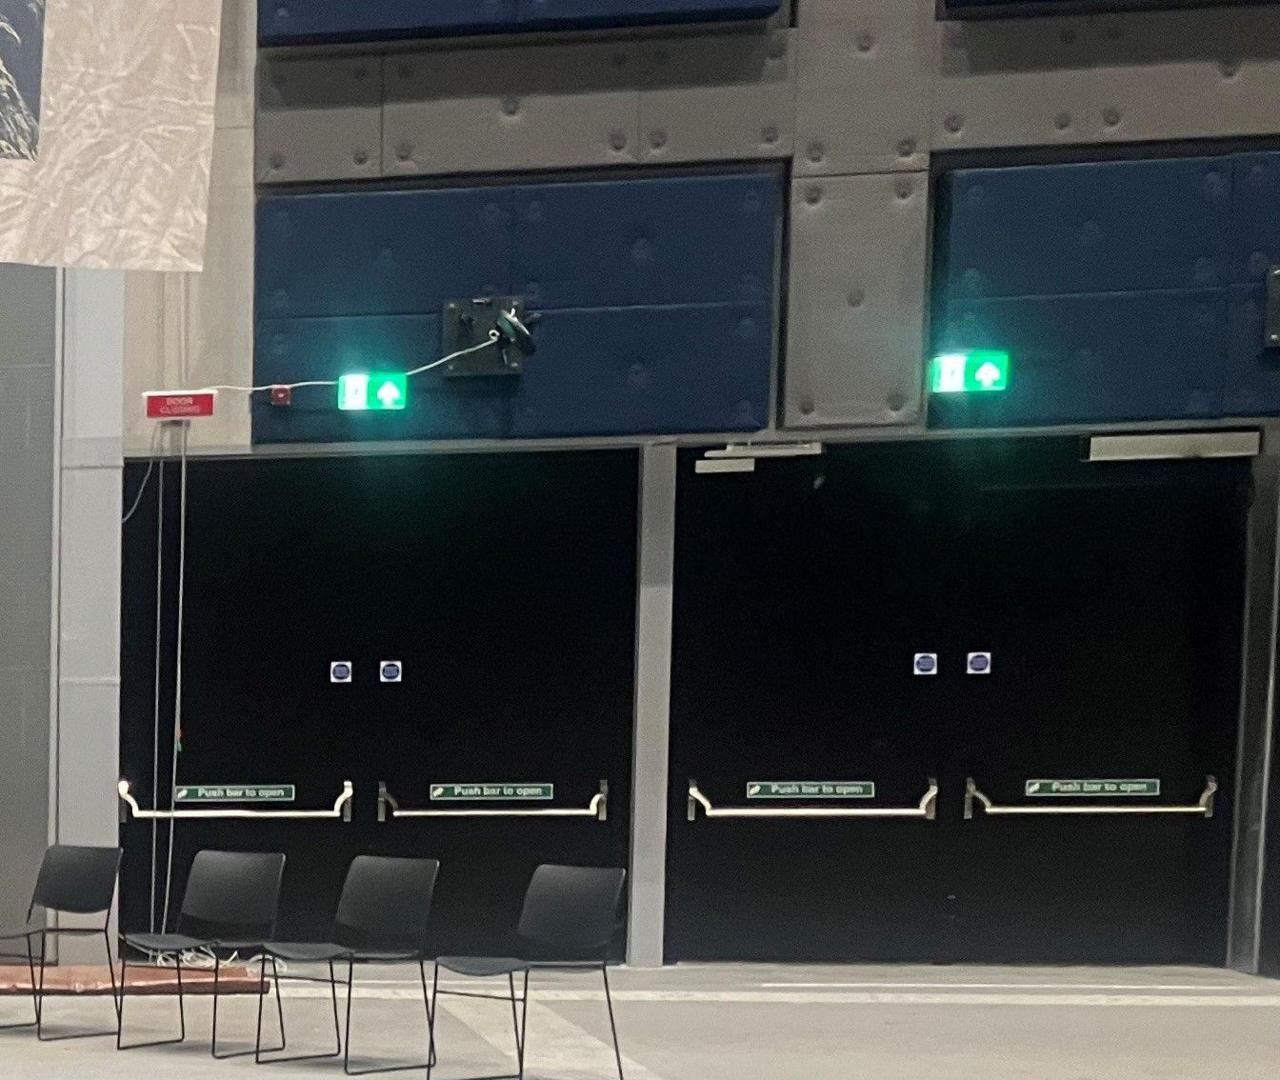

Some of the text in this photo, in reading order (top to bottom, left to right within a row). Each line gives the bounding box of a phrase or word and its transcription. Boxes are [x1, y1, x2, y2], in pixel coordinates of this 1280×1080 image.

[198, 788, 284, 798] Push bar to open
[454, 785, 542, 797] Push bar to open
[771, 784, 863, 795] Push bar to open
[1052, 782, 1147, 793] Push bar to open
